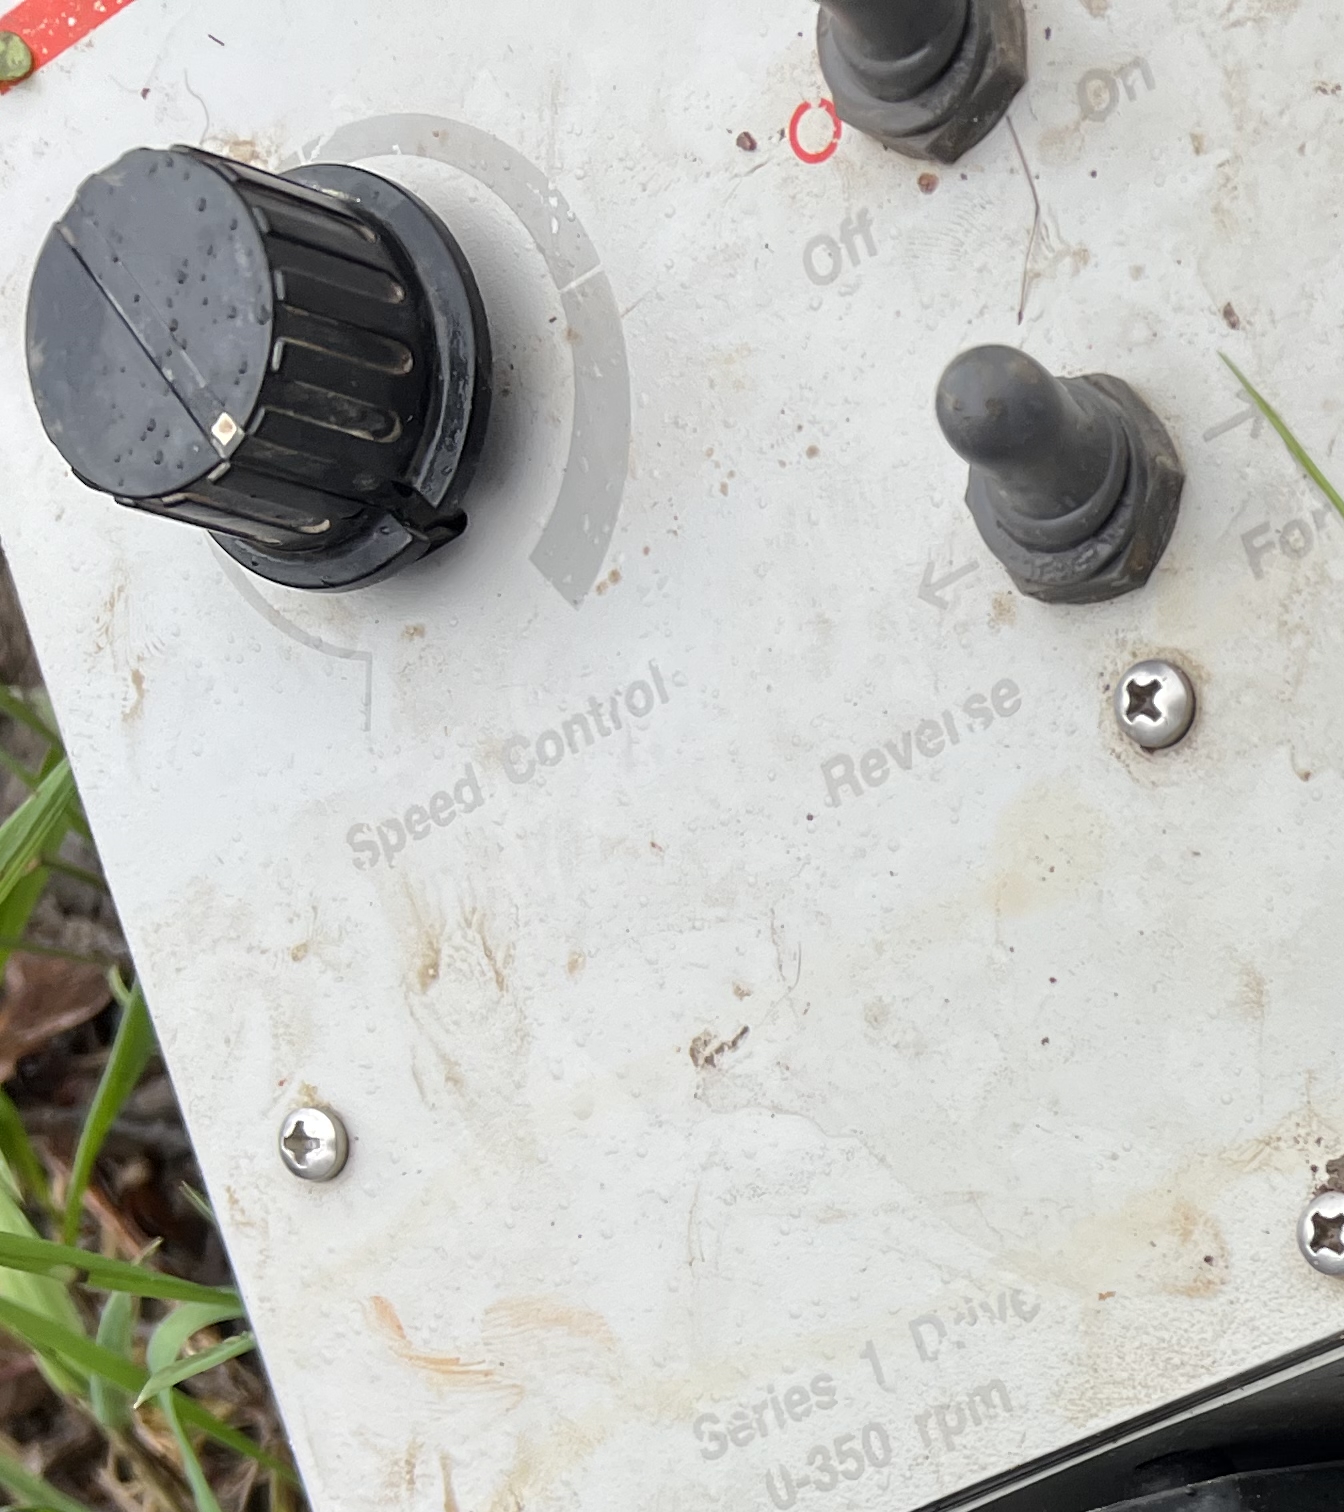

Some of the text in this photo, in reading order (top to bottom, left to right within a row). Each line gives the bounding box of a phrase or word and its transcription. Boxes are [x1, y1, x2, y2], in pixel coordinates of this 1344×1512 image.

[1076, 56, 1157, 123] On
[802, 207, 879, 287] Off
[346, 658, 670, 870] Speed Control
[820, 677, 1023, 808] Reverse
[693, 1372, 838, 1461] Series
[860, 1339, 887, 1388] 1
[913, 1378, 1013, 1451] rpm
